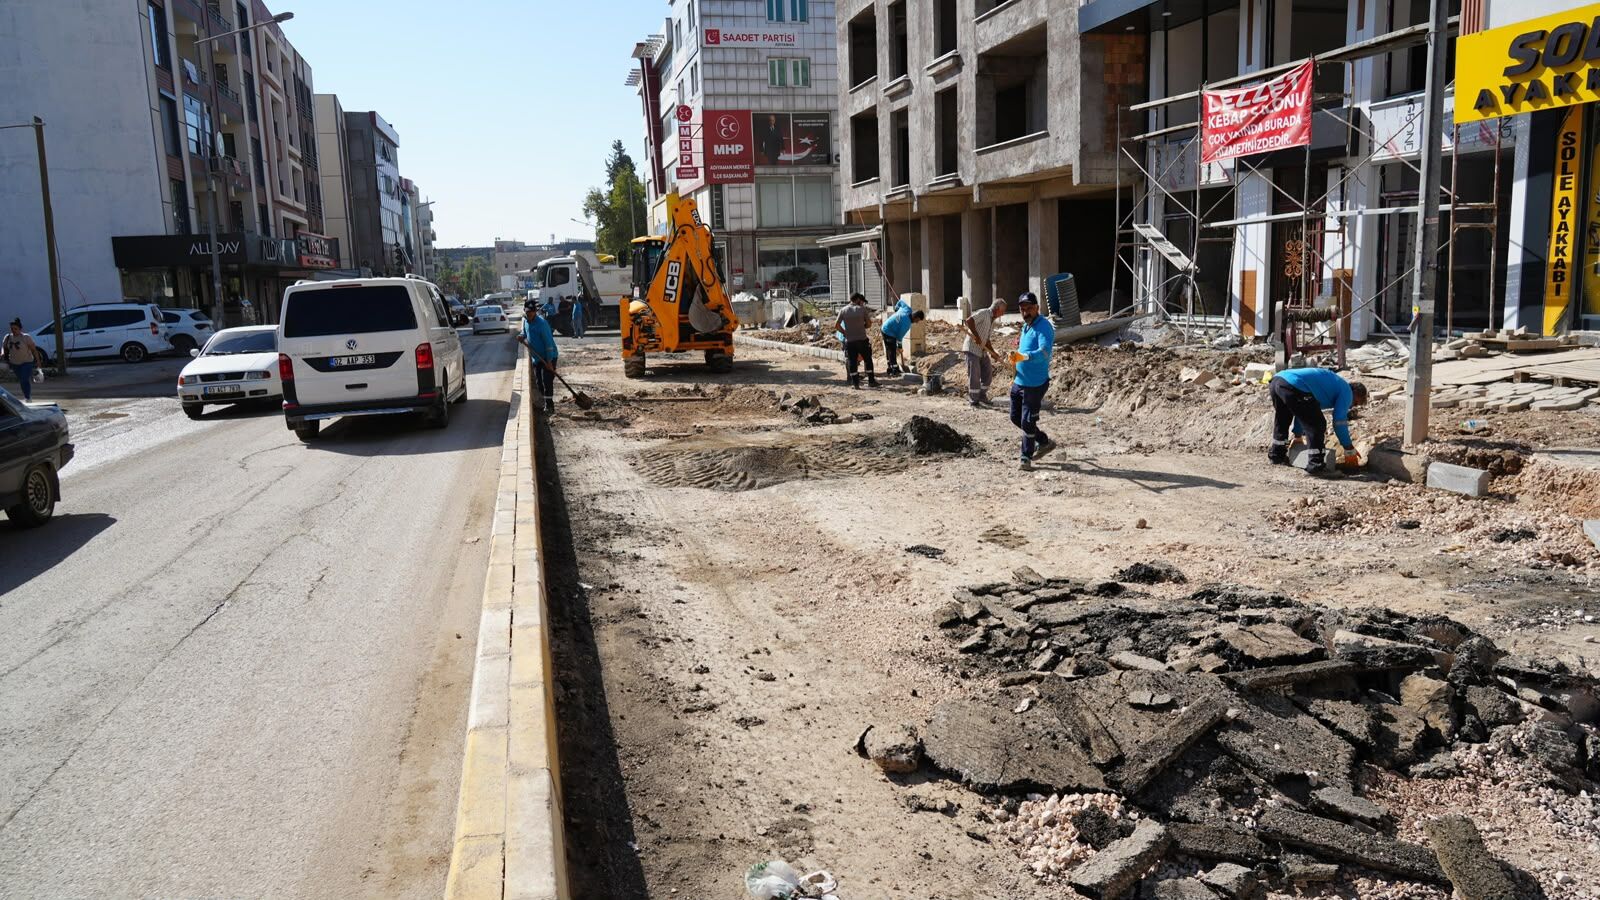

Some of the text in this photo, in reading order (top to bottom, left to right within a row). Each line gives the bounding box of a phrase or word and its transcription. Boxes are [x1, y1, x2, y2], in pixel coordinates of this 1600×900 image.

[722, 33, 795, 42] SAADET PARTİSİ
[1208, 69, 1304, 112] LEZZET
[1208, 109, 1247, 129] KEBAP
[1209, 132, 1228, 149] ÇOK
[1264, 114, 1302, 131] BURADA
[681, 127, 690, 164] MHP
[713, 144, 744, 155] MHP
[1552, 131, 1576, 296] SOLE AYAKKABI
[665, 261, 681, 302] JCB
[347, 355, 359, 366] AAP
[362, 353, 375, 364] 353
